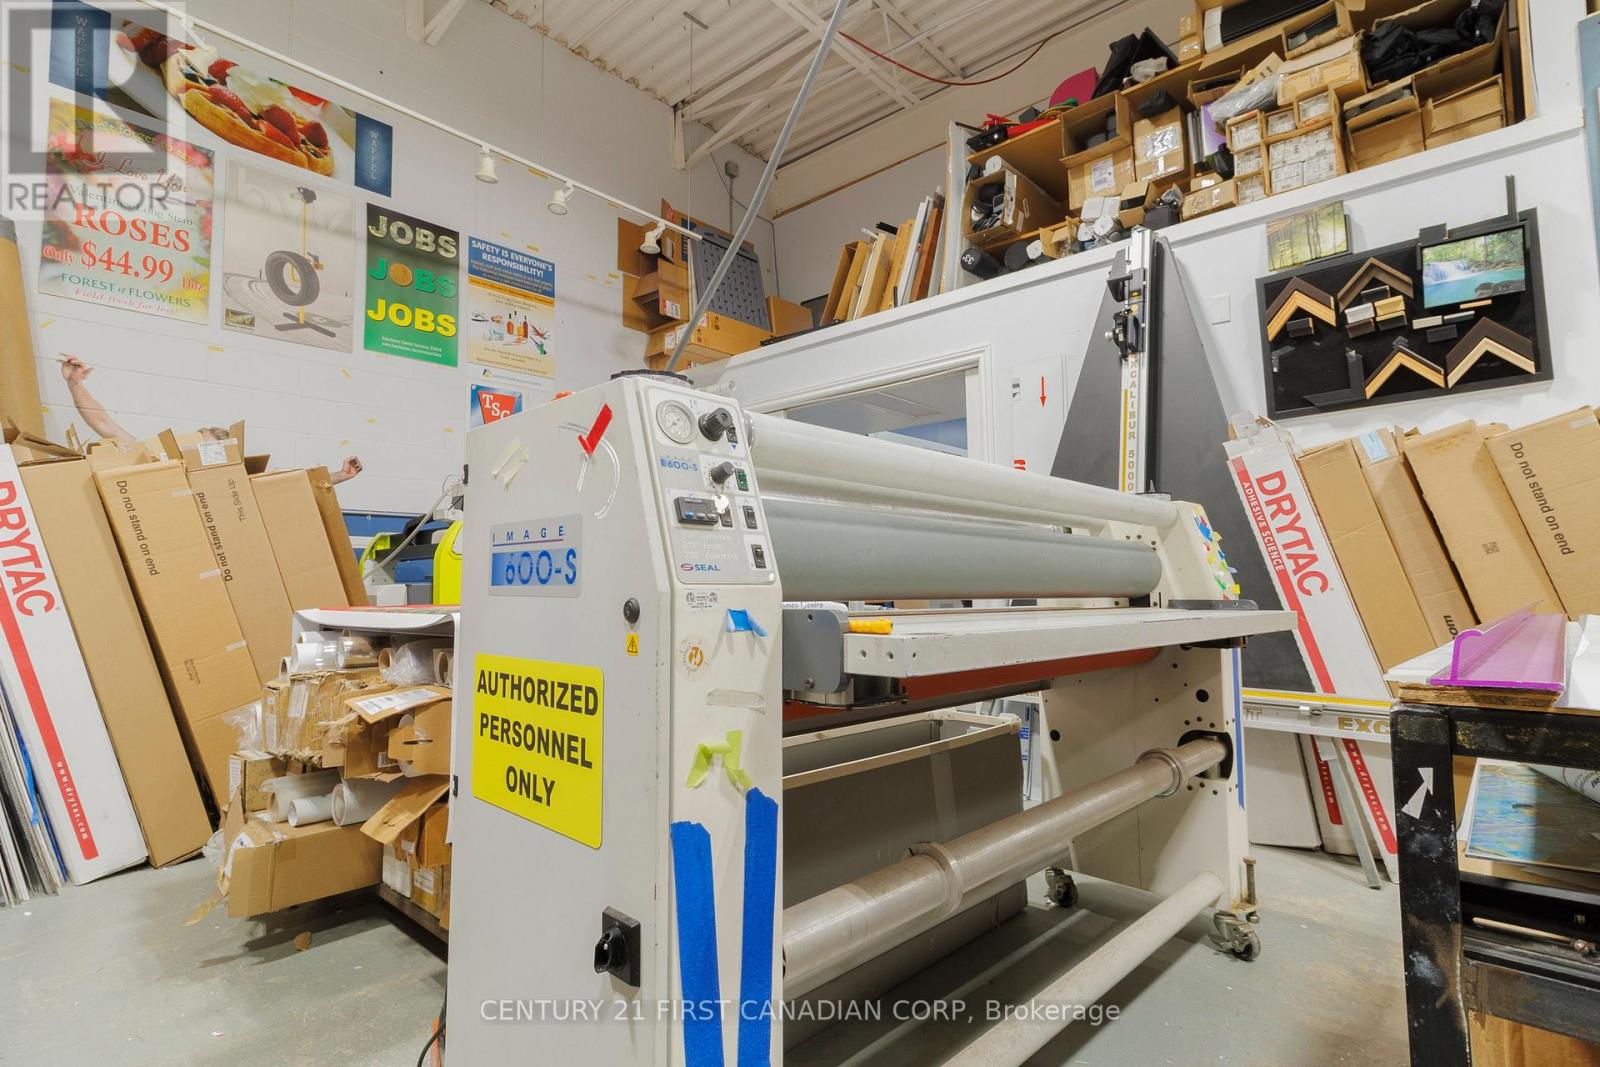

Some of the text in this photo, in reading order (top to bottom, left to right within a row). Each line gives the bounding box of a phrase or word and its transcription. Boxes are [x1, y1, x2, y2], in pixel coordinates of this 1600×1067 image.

[109, 158, 149, 181] Love
[157, 167, 192, 193] You
[73, 202, 190, 252] ROSES
[368, 215, 457, 258] JOBS
[43, 244, 75, 265] Only
[81, 240, 174, 283] $44.99
[471, 240, 553, 272] SAFETY IS EVERYONE'S
[482, 252, 544, 278] RESPONSIBILITY!
[61, 273, 115, 291] FOREST
[129, 287, 191, 307] FLOWERS
[368, 257, 457, 299] JOBS
[367, 298, 457, 337] JOBS
[1127, 450, 1136, 491] 5000
[232, 490, 242, 506] Side
[1510, 441, 1575, 555] Do not stand on end
[0, 480, 55, 616] DRYTAC
[116, 480, 160, 576] Do not stand on end
[196, 491, 233, 582] Do not stand on end
[492, 525, 566, 544] IMAGE
[1242, 482, 1285, 573] ADHESIVE SCIENCE
[1256, 470, 1329, 596] DRYTAC
[505, 548, 577, 585] 600-S
[695, 564, 721, 572] SEAL
[477, 669, 599, 716] AUTHORIZED
[479, 712, 593, 769] PERSONNEL
[57, 761, 88, 840] www.drytac.com
[505, 765, 556, 807] ONLY
